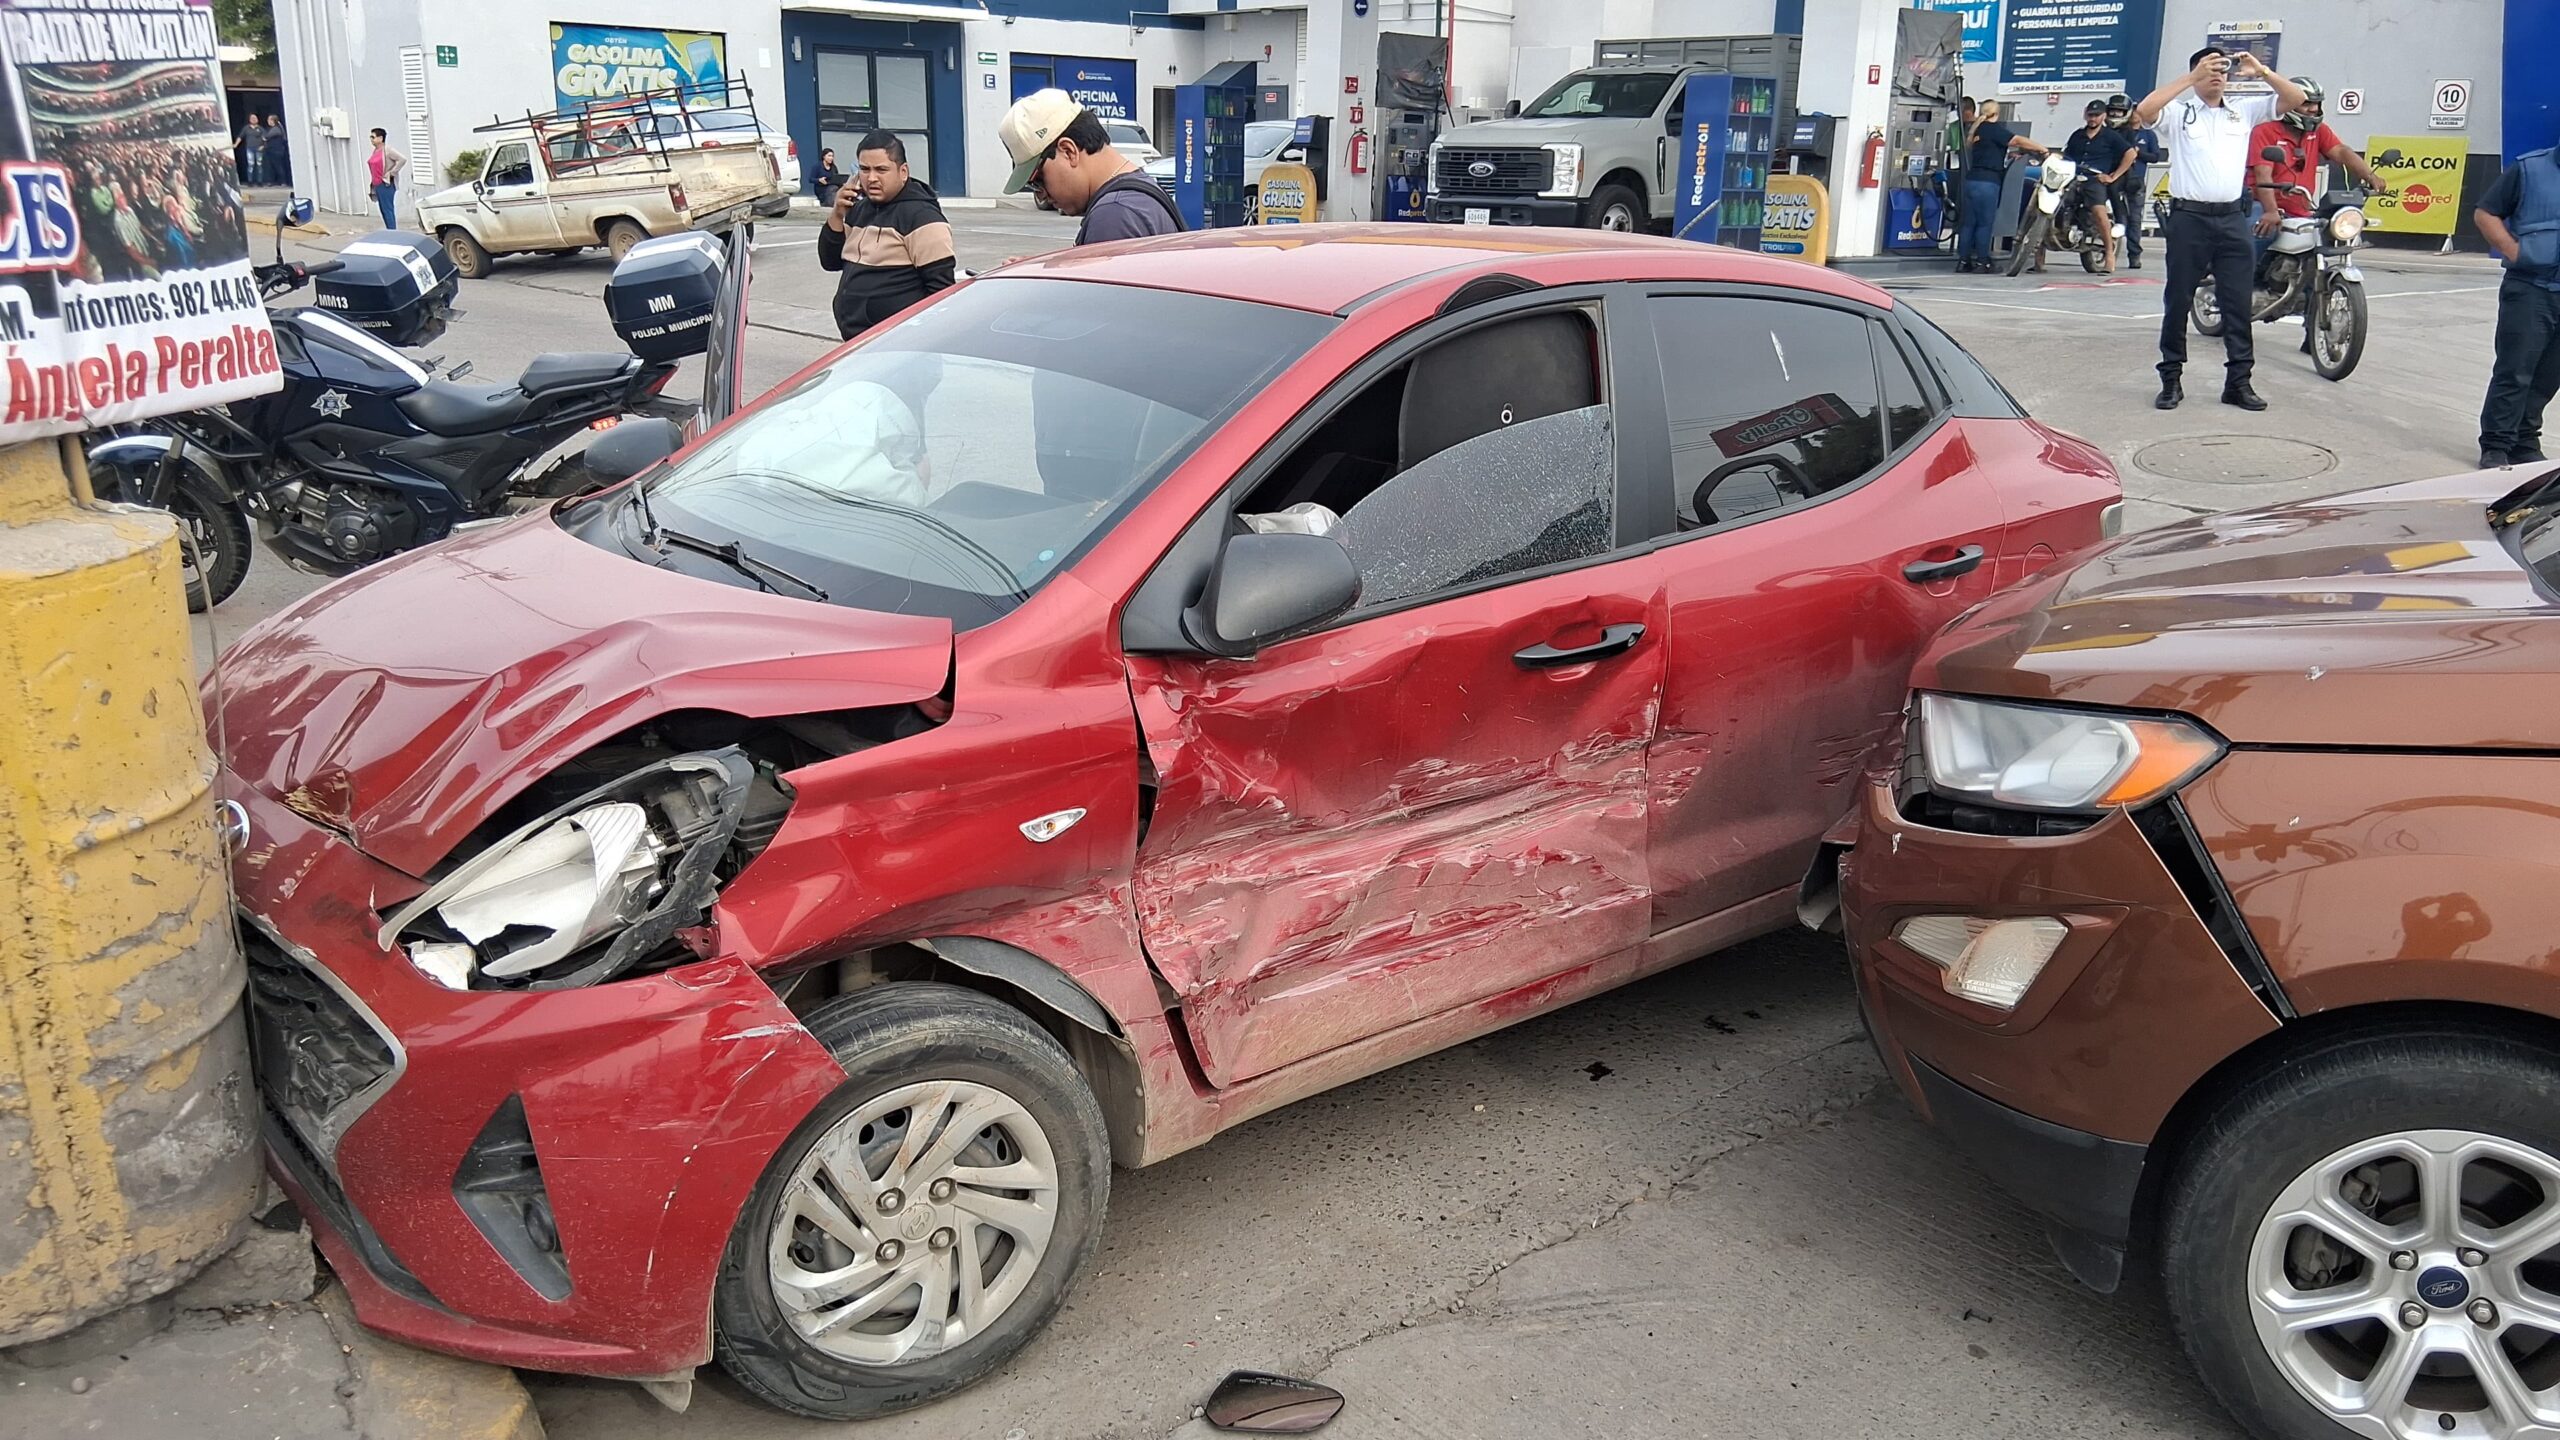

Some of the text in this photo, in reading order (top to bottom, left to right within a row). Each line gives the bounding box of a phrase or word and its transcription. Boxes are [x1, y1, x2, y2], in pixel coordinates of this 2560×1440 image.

[1957, 5, 1991, 28] UÍ
[2020, 3, 2124, 17] GUARDIA DE SEGURIDAD
[2018, 16, 2118, 29] PERSONAL DE LIMPIEZA
[80, 12, 117, 62] DE
[567, 44, 665, 67] GASOLINA
[557, 63, 678, 100] GRATIS
[986, 76, 994, 87] E
[1072, 90, 1118, 103] OFICINA
[2442, 90, 2460, 103] 10
[1691, 123, 1709, 206] Redpetroil
[2371, 156, 2457, 170] PGA CON
[1267, 180, 1301, 190] GASOLINA
[1262, 191, 1305, 209] GRATIS
[2378, 198, 2398, 208] Car
[2403, 192, 2453, 204] Edenred
[1762, 208, 1817, 231] RATIS
[63, 292, 170, 333] nformes:
[169, 281, 209, 318] 982
[211, 275, 258, 312] 44.46
[318, 294, 348, 309] MM13
[648, 295, 676, 314] MM
[632, 326, 665, 339] POLICIA
[4, 324, 280, 424] Ángela Peralta
